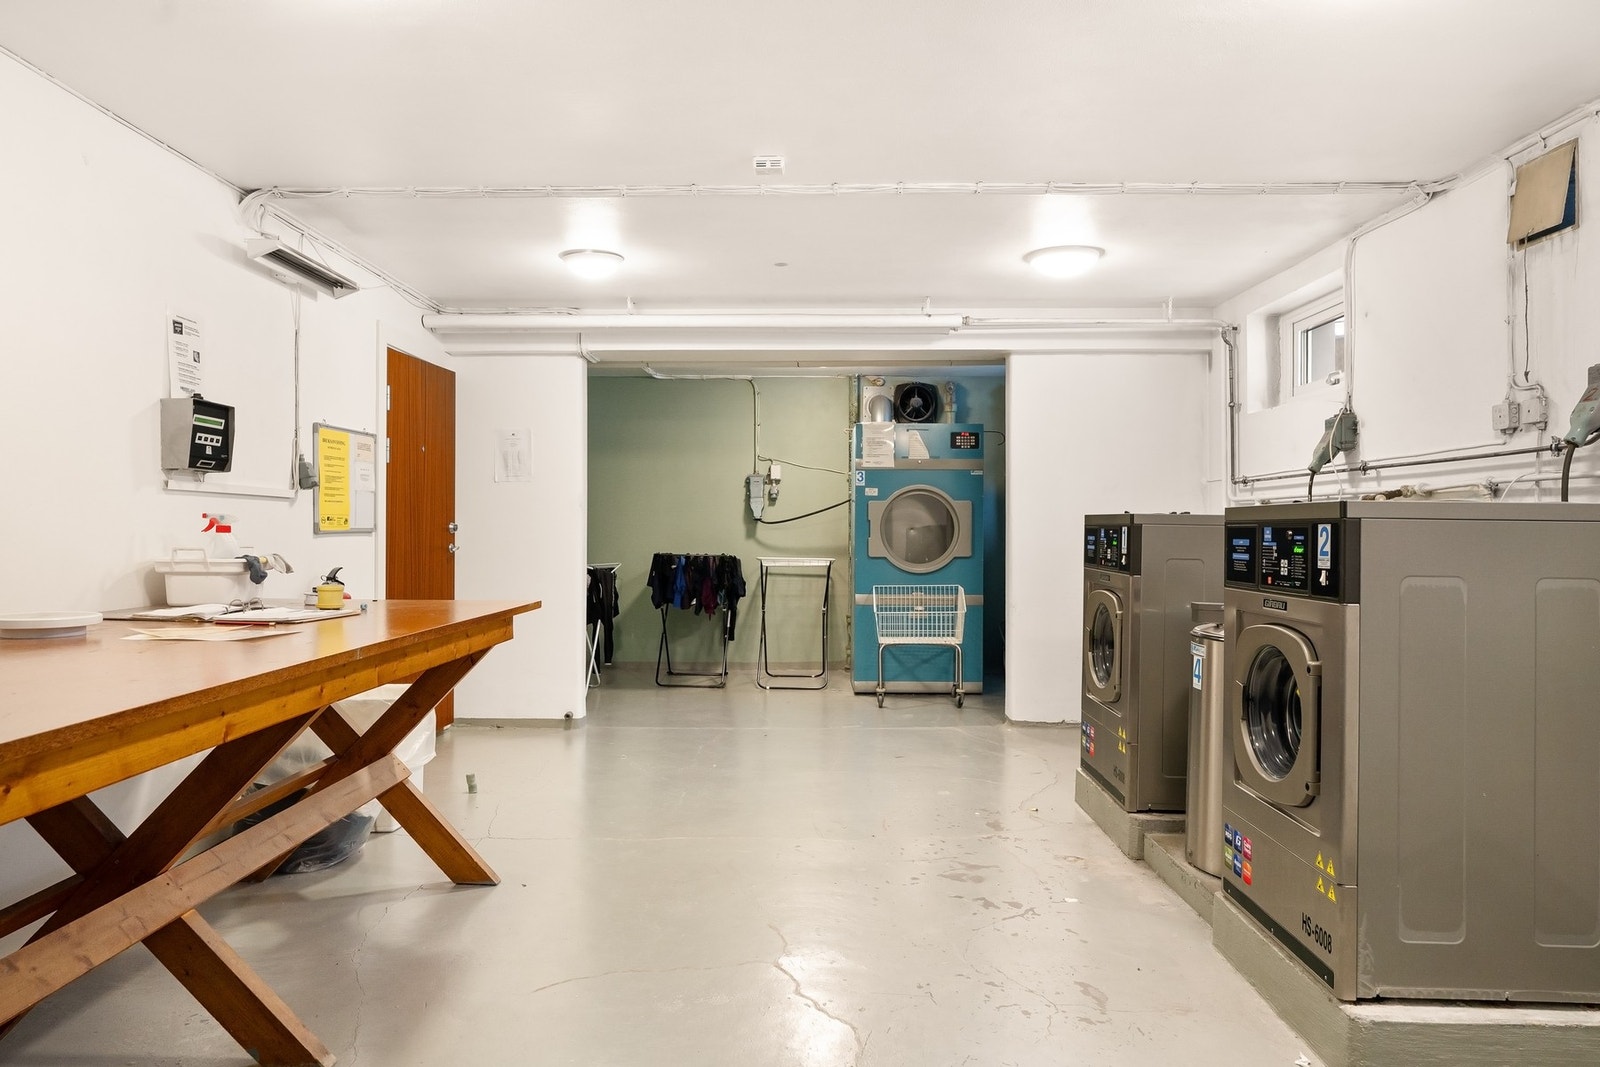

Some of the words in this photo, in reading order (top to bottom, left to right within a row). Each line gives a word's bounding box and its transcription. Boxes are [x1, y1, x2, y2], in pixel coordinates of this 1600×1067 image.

[856, 471, 864, 482] 3
[1319, 526, 1329, 557] 2
[1194, 658, 1201, 684] 4
[1301, 912, 1333, 954] HS-6008
